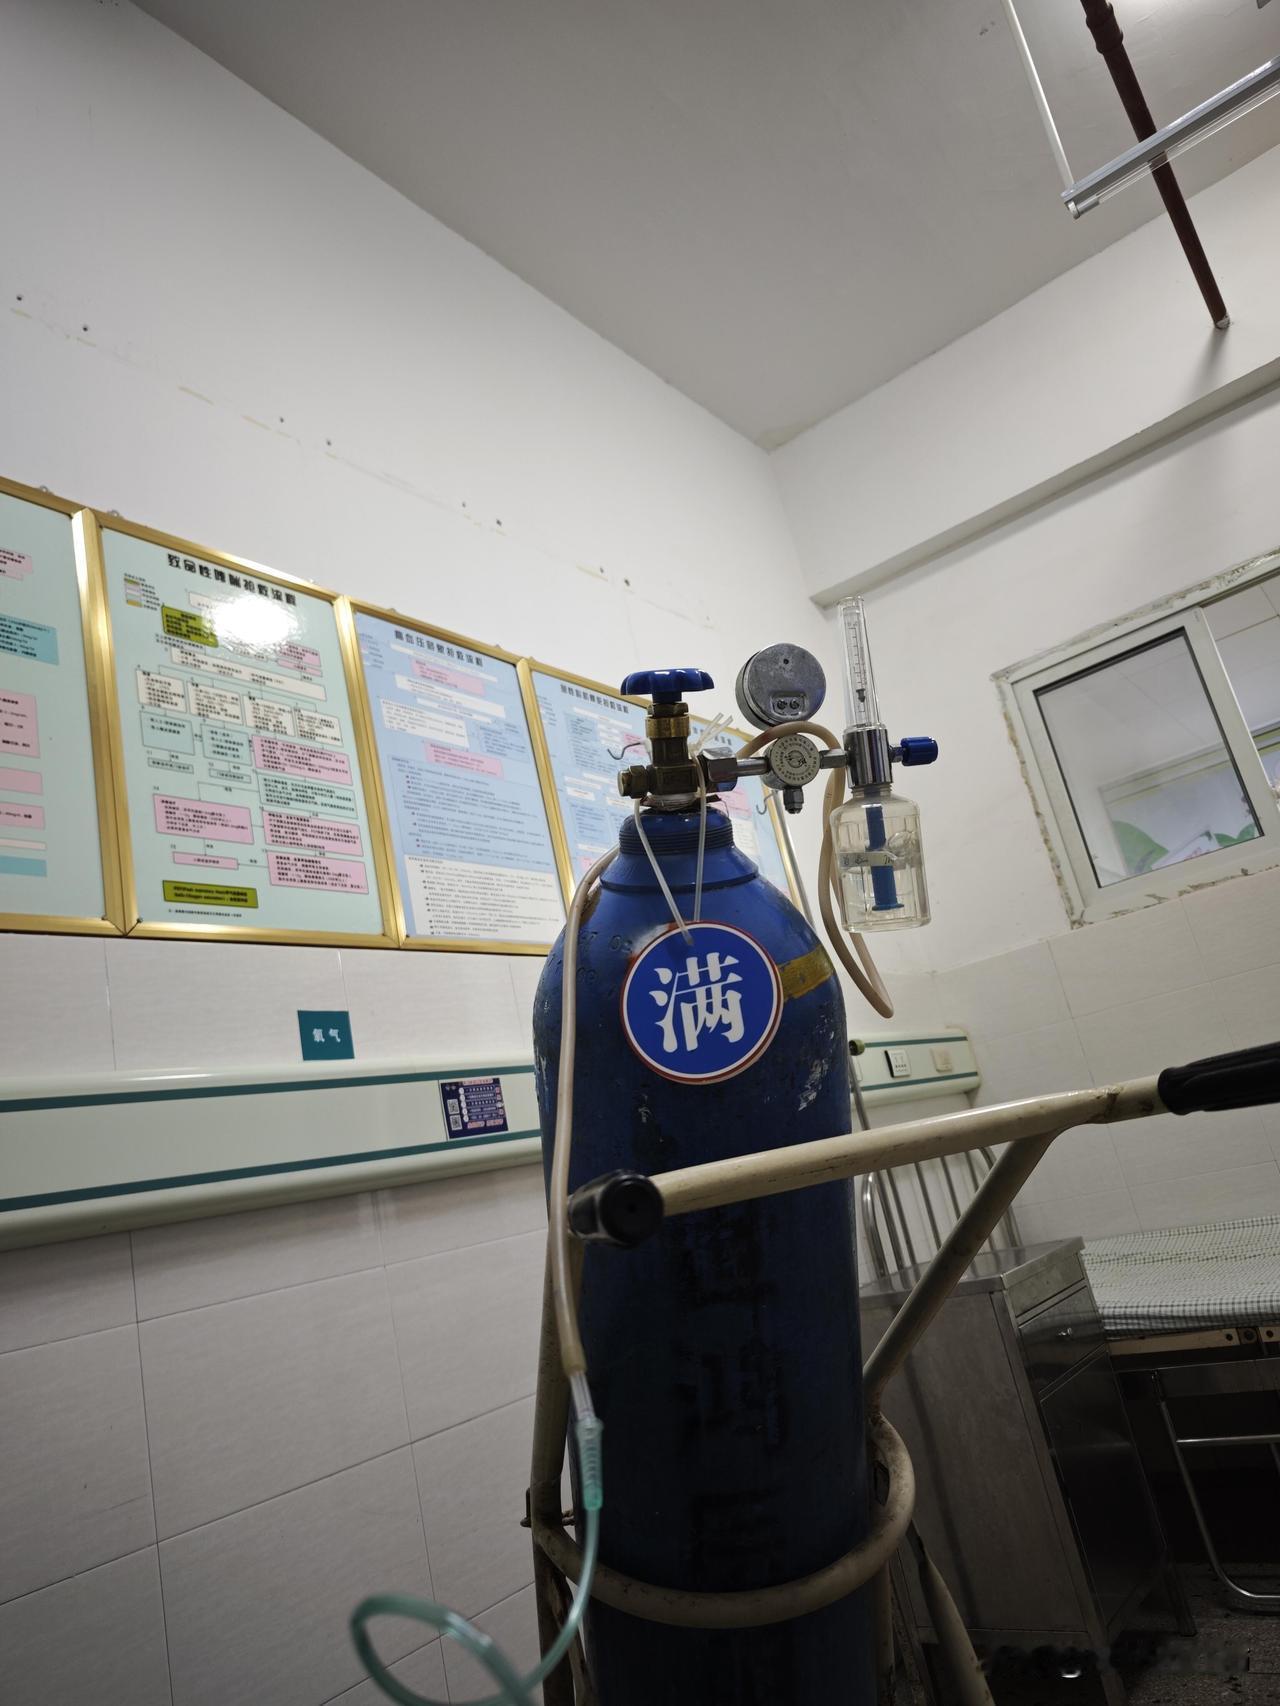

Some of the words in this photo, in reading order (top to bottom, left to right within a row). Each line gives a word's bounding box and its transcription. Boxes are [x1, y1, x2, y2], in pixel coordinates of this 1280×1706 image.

[167, 553, 297, 606] 致命性哮喘抢救流程
[648, 952, 745, 1053] 满
[312, 1028, 341, 1043] 氧气
